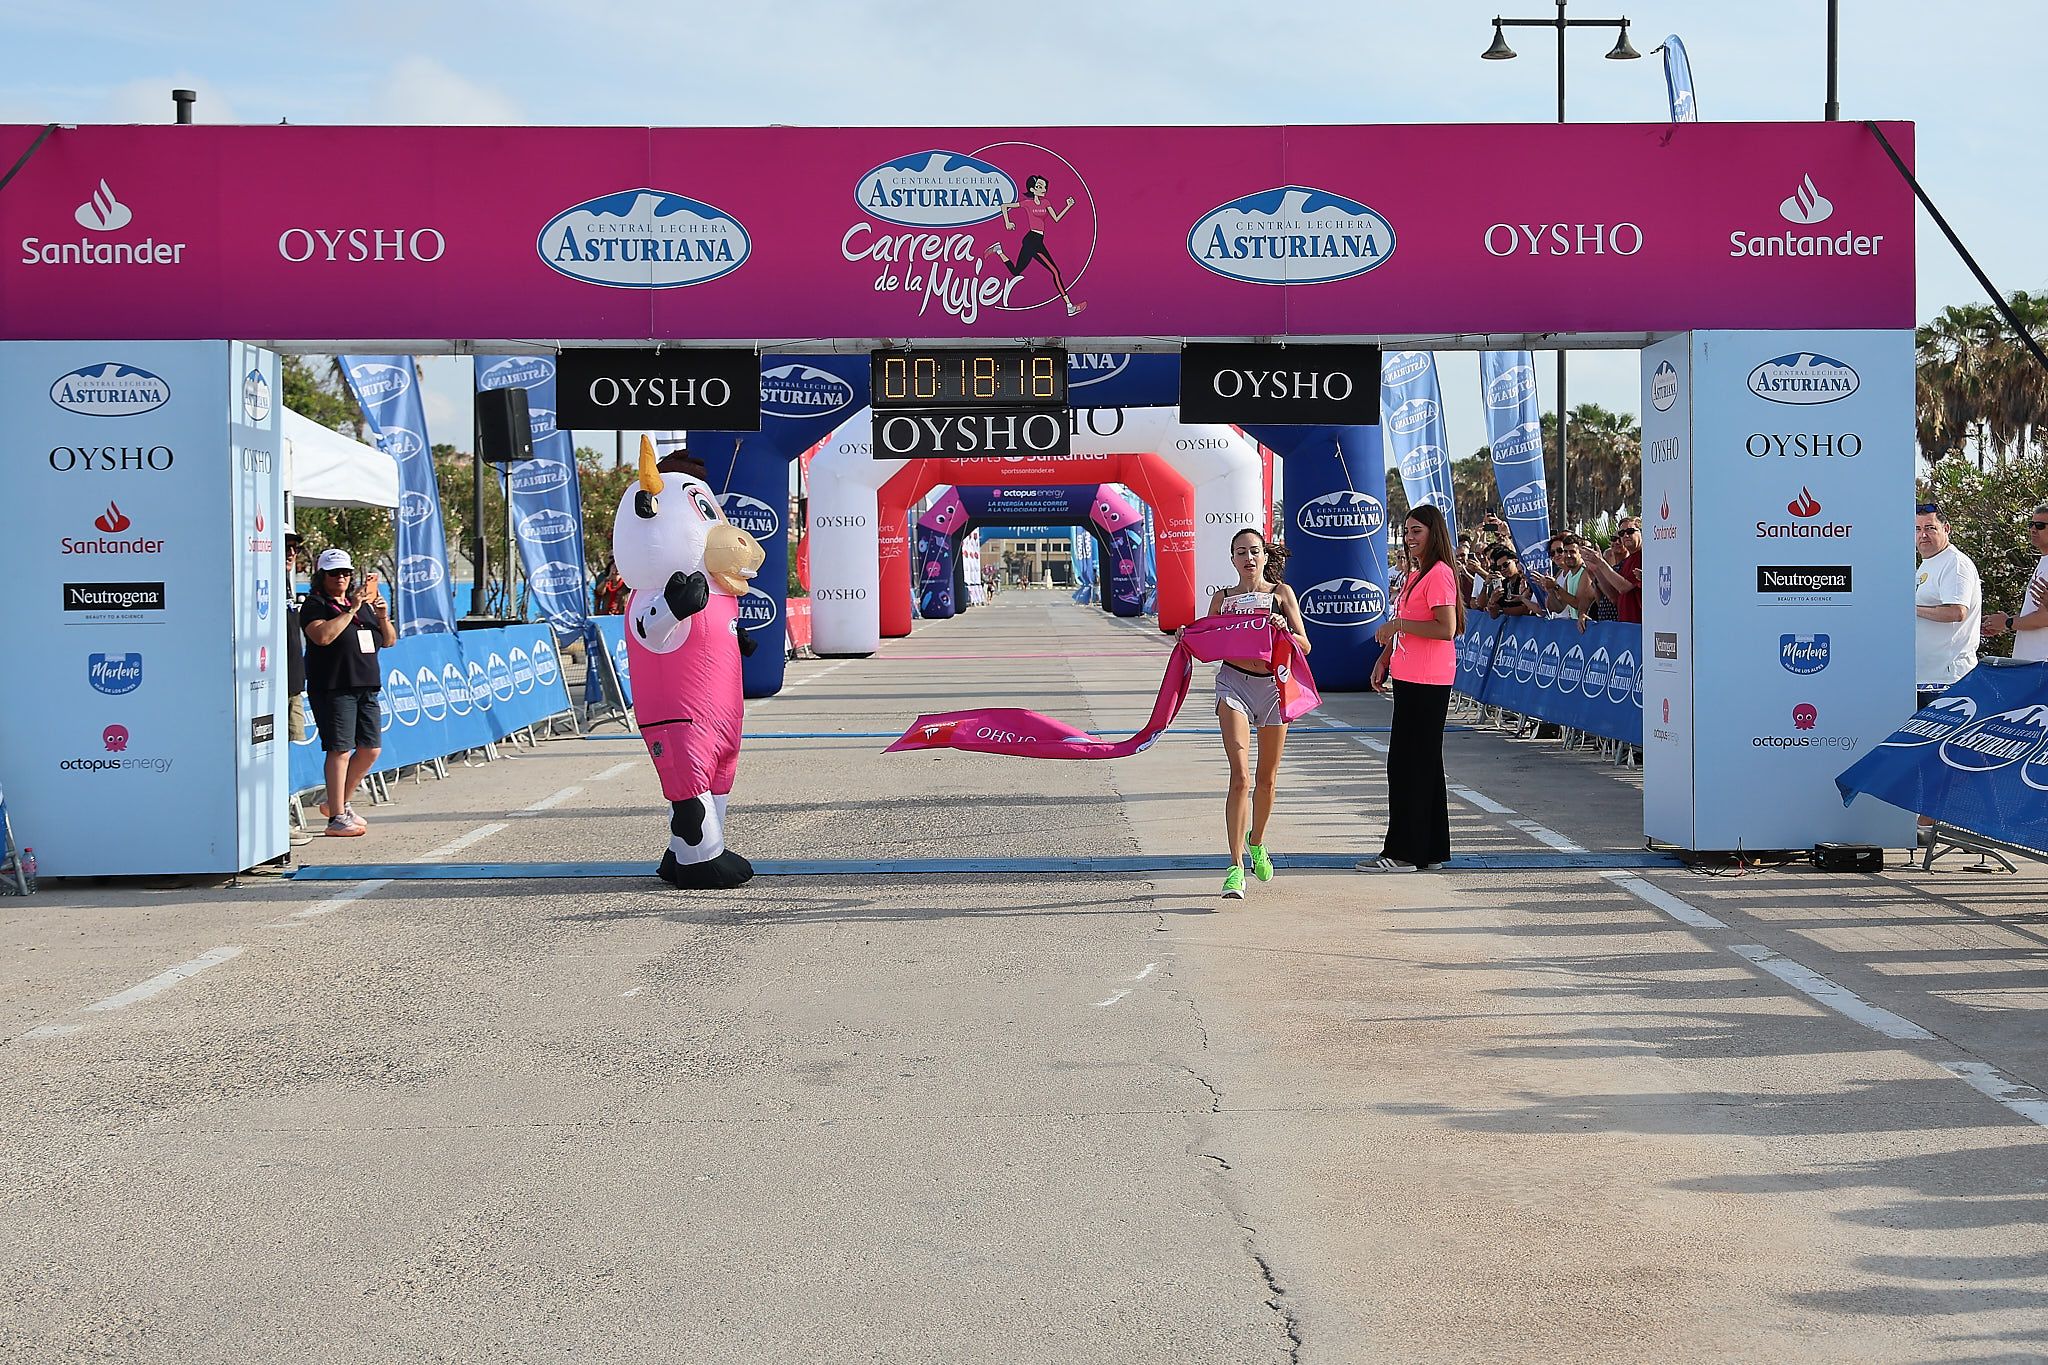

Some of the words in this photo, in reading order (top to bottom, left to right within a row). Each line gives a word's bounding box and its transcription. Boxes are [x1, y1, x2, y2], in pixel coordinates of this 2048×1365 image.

[892, 176, 943, 185] CENTRAL
[946, 176, 1000, 185] LECHERA
[868, 178, 1003, 208] ASTURIANA
[587, 223, 653, 233] CENTRAL
[660, 223, 728, 234] LECHERA
[1236, 221, 1300, 231] CENTRAL
[1307, 221, 1373, 231] LECHERA
[278, 228, 446, 262] OYSHO
[554, 225, 735, 263] ASTURIANA
[841, 223, 976, 263] Carrera
[1204, 224, 1379, 260] ASTURIANA
[1484, 223, 1643, 257] OYSHO
[1729, 231, 1883, 257] Santander
[22, 237, 186, 264] Santander
[874, 267, 898, 292] de
[904, 270, 923, 292] la
[919, 260, 1024, 324] Mujer
[804, 383, 843, 391] LECHERA
[1213, 369, 1352, 400] OYSHO
[1755, 372, 1852, 392] ASTURIANA
[59, 383, 162, 403] ASTURIANA
[589, 377, 731, 407] OYSHO
[761, 388, 844, 405] STURIANA
[882, 414, 1060, 453] OYSHO
[1176, 438, 1229, 450] OYSHO
[1651, 437, 1679, 464] OYSHO
[1746, 433, 1862, 458] OYSHO
[49, 446, 174, 471] OYSHO
[243, 448, 272, 475] OYSHO
[1004, 489, 1036, 498] octopus
[1037, 490, 1064, 498] energy
[729, 517, 773, 532] RIANA
[817, 516, 866, 529] OYSHO
[878, 523, 894, 532] orts
[1169, 518, 1193, 527] Sports
[1205, 512, 1254, 524] OYSHO
[1303, 509, 1382, 528] ASTURIANA
[1756, 522, 1852, 538] Santander
[61, 537, 164, 554] Santander
[1764, 572, 1845, 590] Neutrogena
[70, 589, 159, 607] Neutrogena
[817, 589, 866, 600] OYSHO
[1304, 597, 1382, 616] ASTURIANA
[1783, 643, 1827, 664] Marlene
[91, 661, 140, 684] Marlene
[1753, 736, 1809, 749] octopus
[1810, 736, 1858, 750] energy
[1948, 723, 2032, 760] ASTURIANA
[60, 758, 121, 772] octopus
[123, 758, 173, 773] energy
